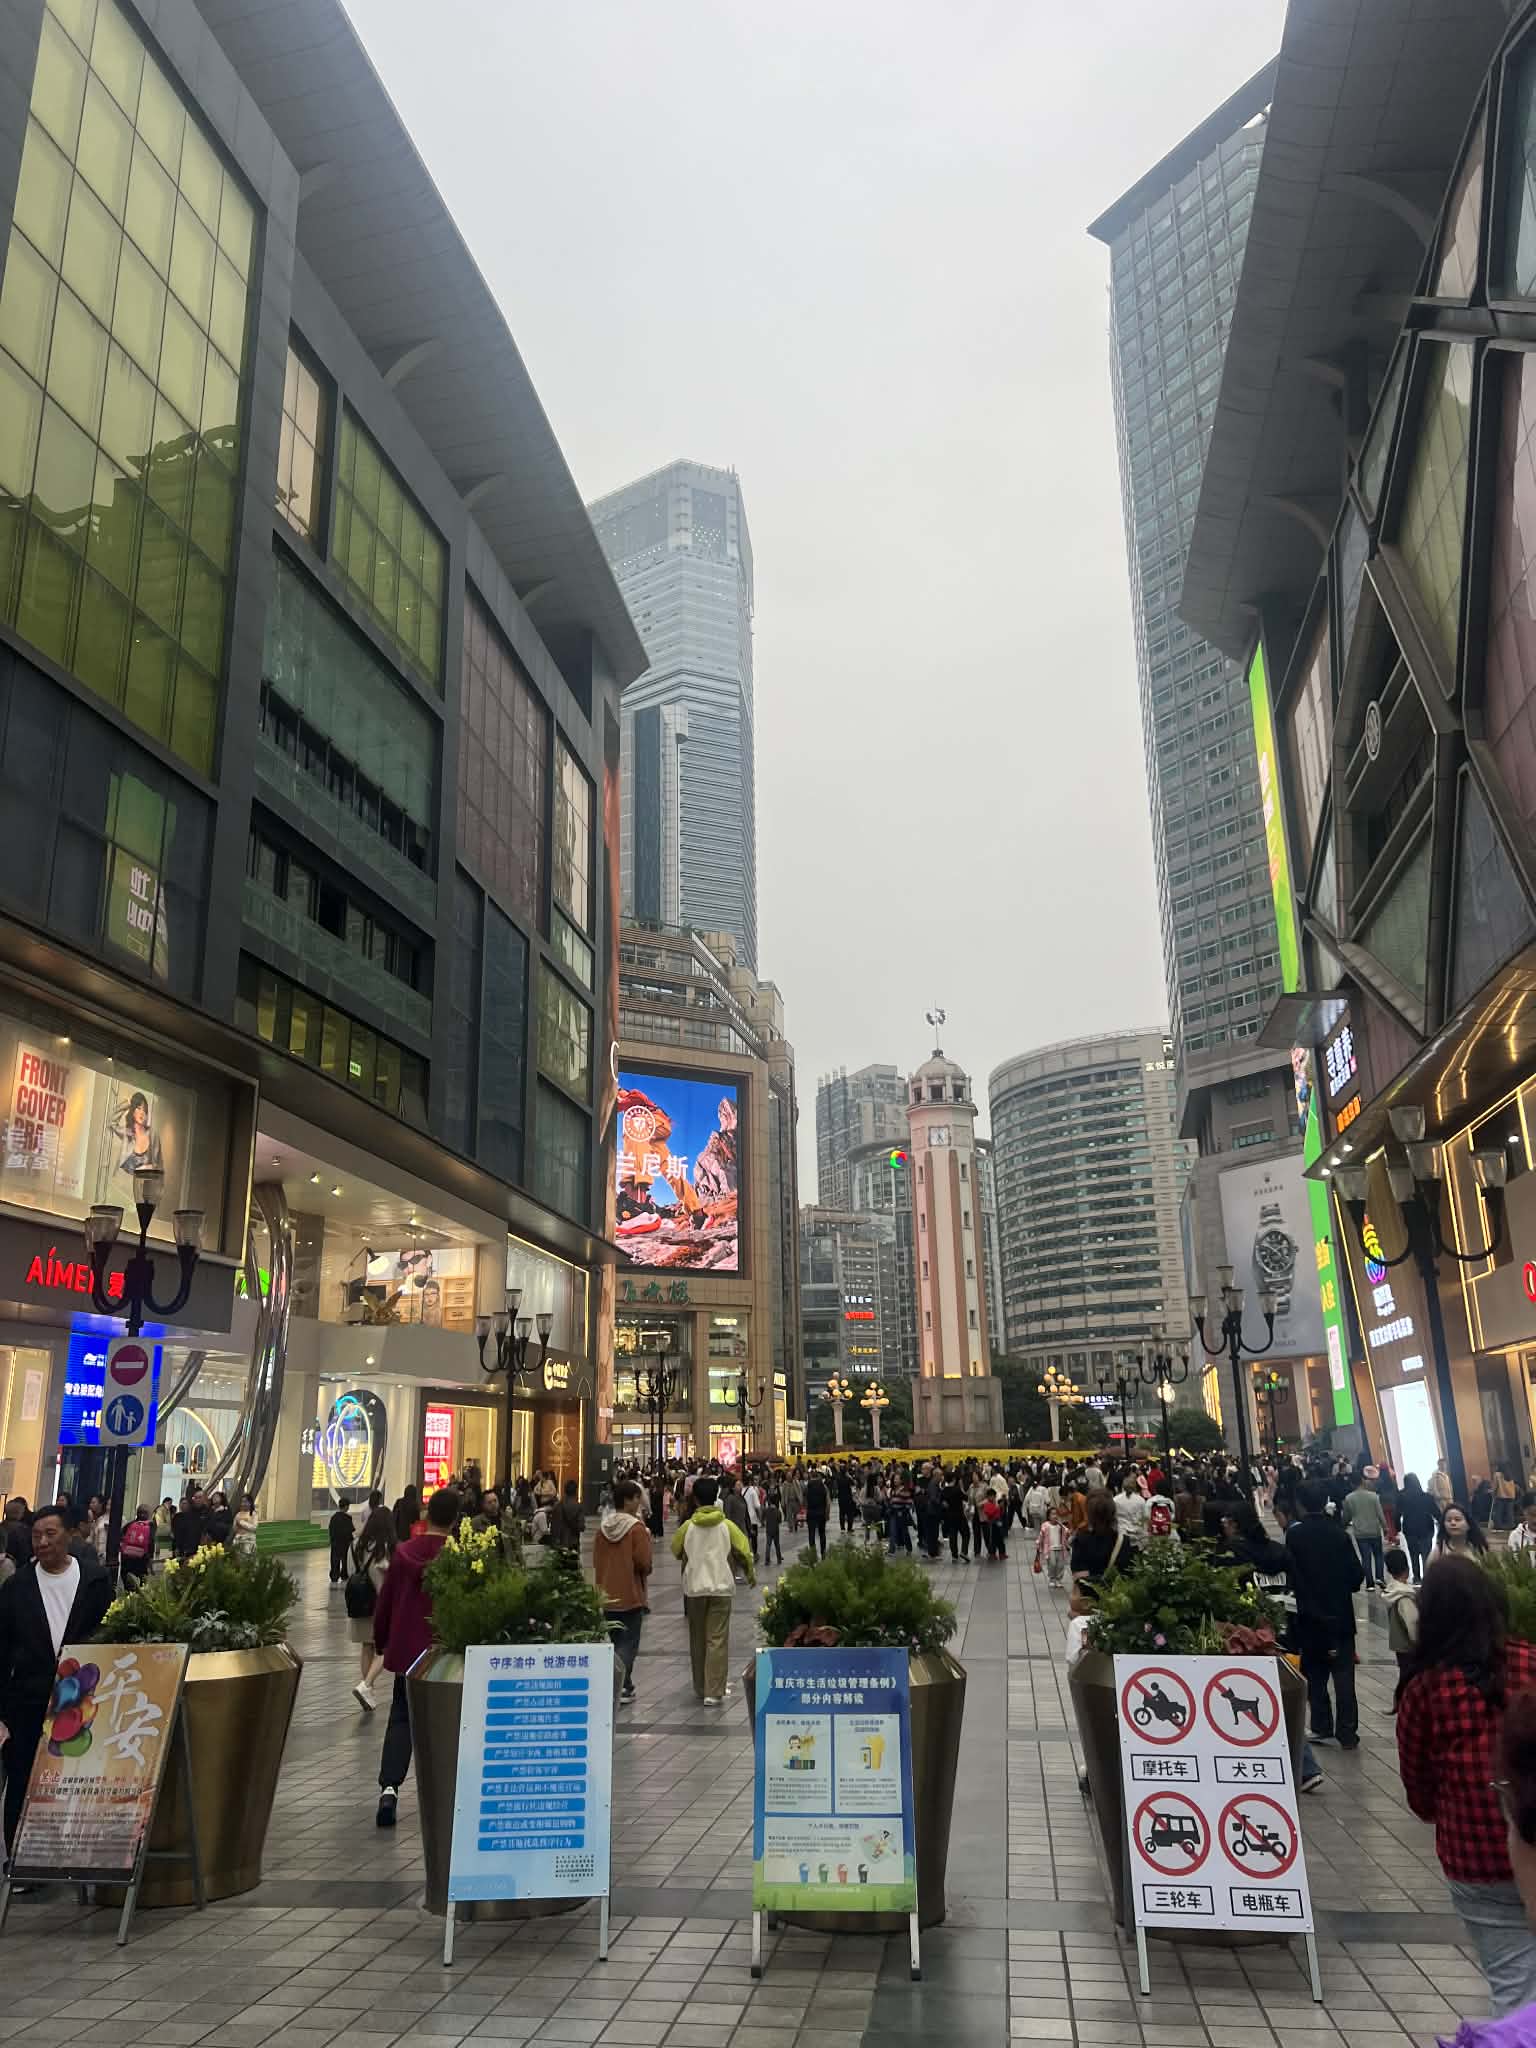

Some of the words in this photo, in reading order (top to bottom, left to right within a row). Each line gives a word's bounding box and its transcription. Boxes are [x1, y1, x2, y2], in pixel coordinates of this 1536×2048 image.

[20, 1052, 70, 1096] FRONT
[16, 1085, 66, 1128] COVER
[489, 1657, 536, 1670] 守序渝中
[543, 1655, 590, 1669] 悦游母城
[768, 1676, 898, 1690] 《重庆市生活垃圾管理条例》
[801, 1693, 864, 1705] 部分内容解读
[92, 1652, 163, 1768] 平安
[1143, 1760, 1188, 1777] 摩托车
[1232, 1762, 1268, 1779] 犬只
[1155, 1890, 1204, 1909] 三轮车
[1242, 1893, 1291, 1913] 电瓶车
